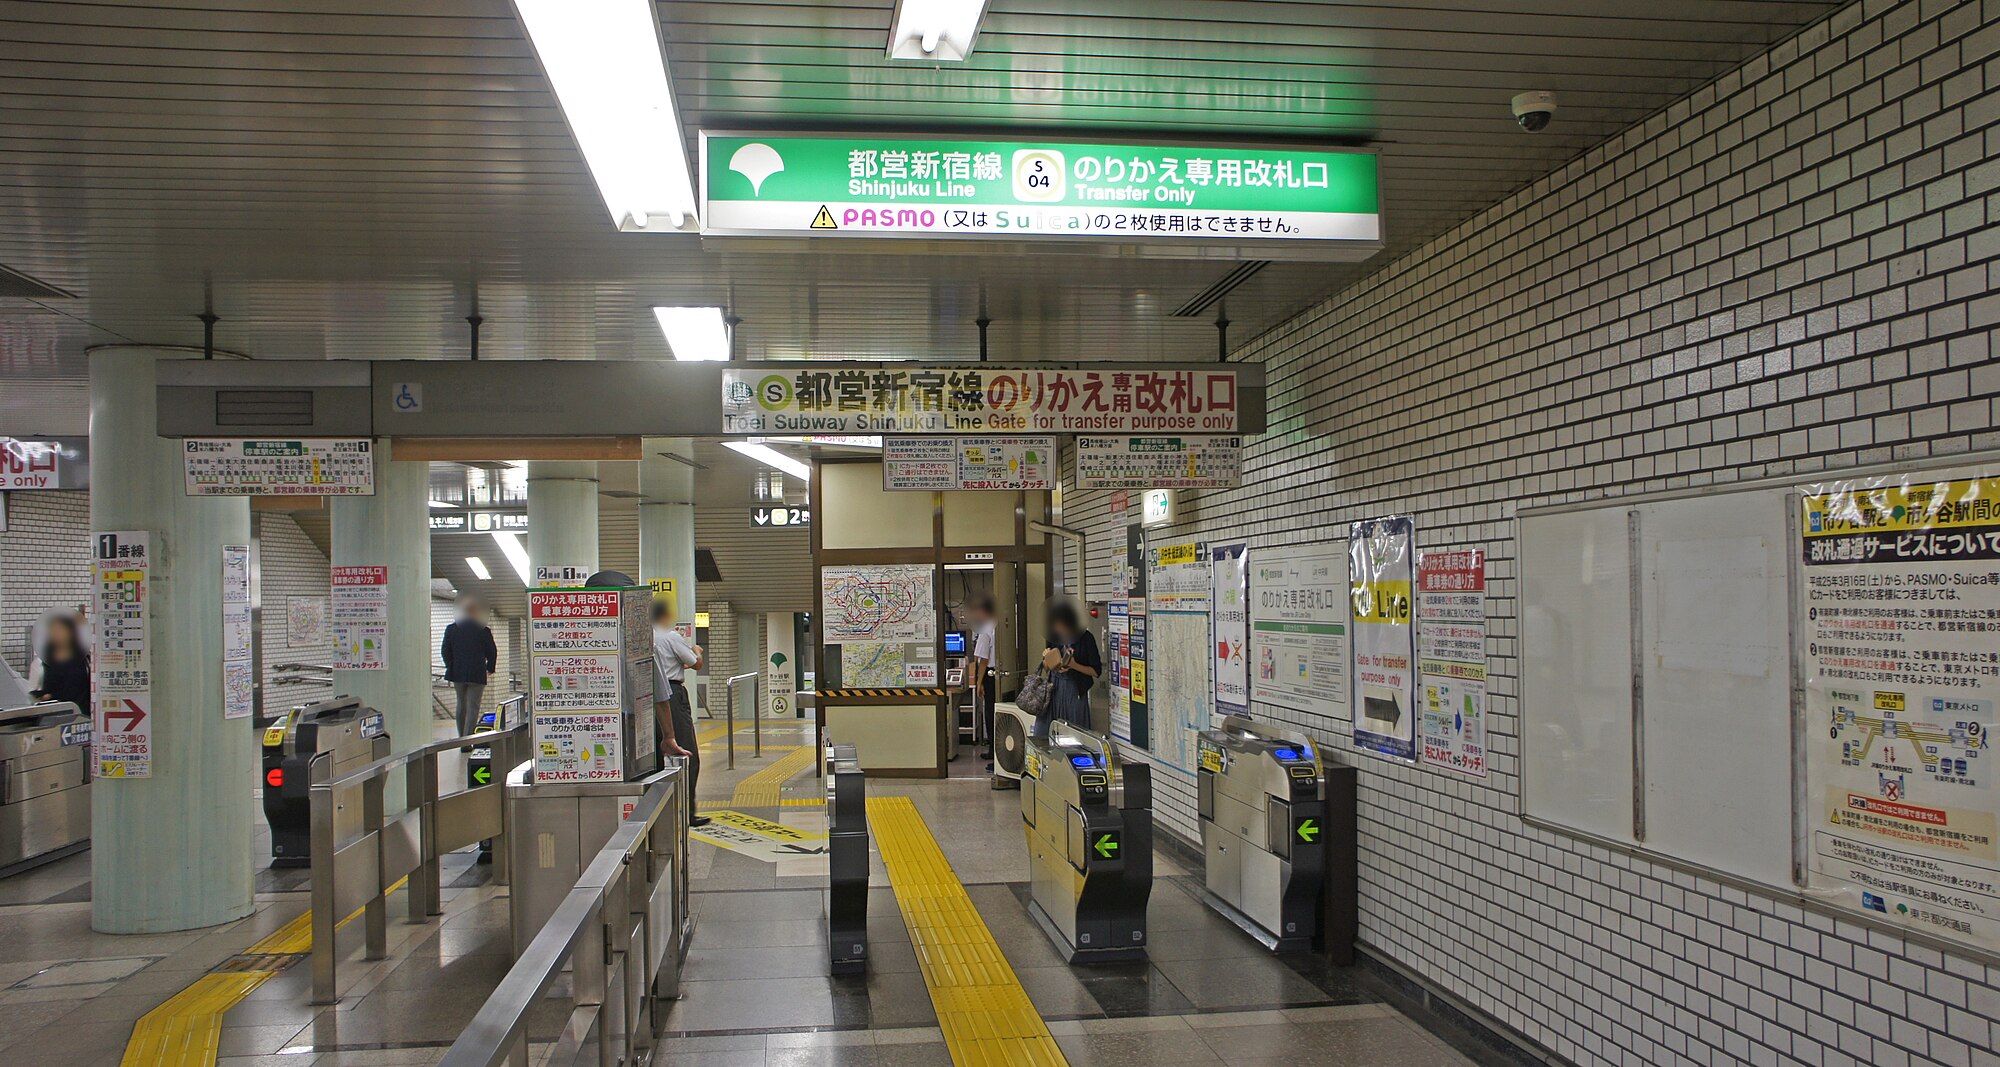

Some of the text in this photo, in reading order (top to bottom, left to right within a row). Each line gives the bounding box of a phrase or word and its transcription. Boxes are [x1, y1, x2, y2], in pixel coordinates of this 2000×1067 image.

[848, 149, 1003, 181] 都営新宿線
[1035, 161, 1043, 172] S
[1073, 156, 1329, 188] のりかえ専用改札口
[849, 180, 975, 199] Shinjuku Line
[1028, 175, 1050, 188] 04
[1074, 184, 1196, 205] Transfer Only
[843, 208, 935, 228] PASMO
[767, 370, 1235, 415] S 都営新宿線 のりかえ専用改札口
[725, 413, 1234, 432] Toei Subway Shinjuku Line Gate for transfer purpose only
[189, 442, 197, 453] 2
[245, 448, 299, 456] 停車駅のご案内
[14, 474, 47, 487] only
[789, 508, 801, 525] 2
[118, 545, 145, 559] 番線
[1811, 529, 2000, 563] 改札通過サービスについて
[650, 580, 672, 592] 出口
[1426, 573, 1475, 590] 乗車券の通り方
[532, 594, 618, 605] のりかえ専用改札口
[1262, 589, 1333, 610] のりかえ専用改札口
[1377, 591, 1408, 618] Line
[541, 605, 609, 617] 乗車券の通り方
[540, 658, 597, 667] ICカード2枚での
[1357, 653, 1368, 666] Gate
[1372, 653, 1381, 667] for
[1383, 656, 1407, 670] transfer
[1818, 645, 2000, 664] 都営新宿線をご利用のお客様は、ご乗車前またはご乗
[1361, 671, 1401, 687] purpose only
[1944, 701, 1979, 712] 東京メトロ
